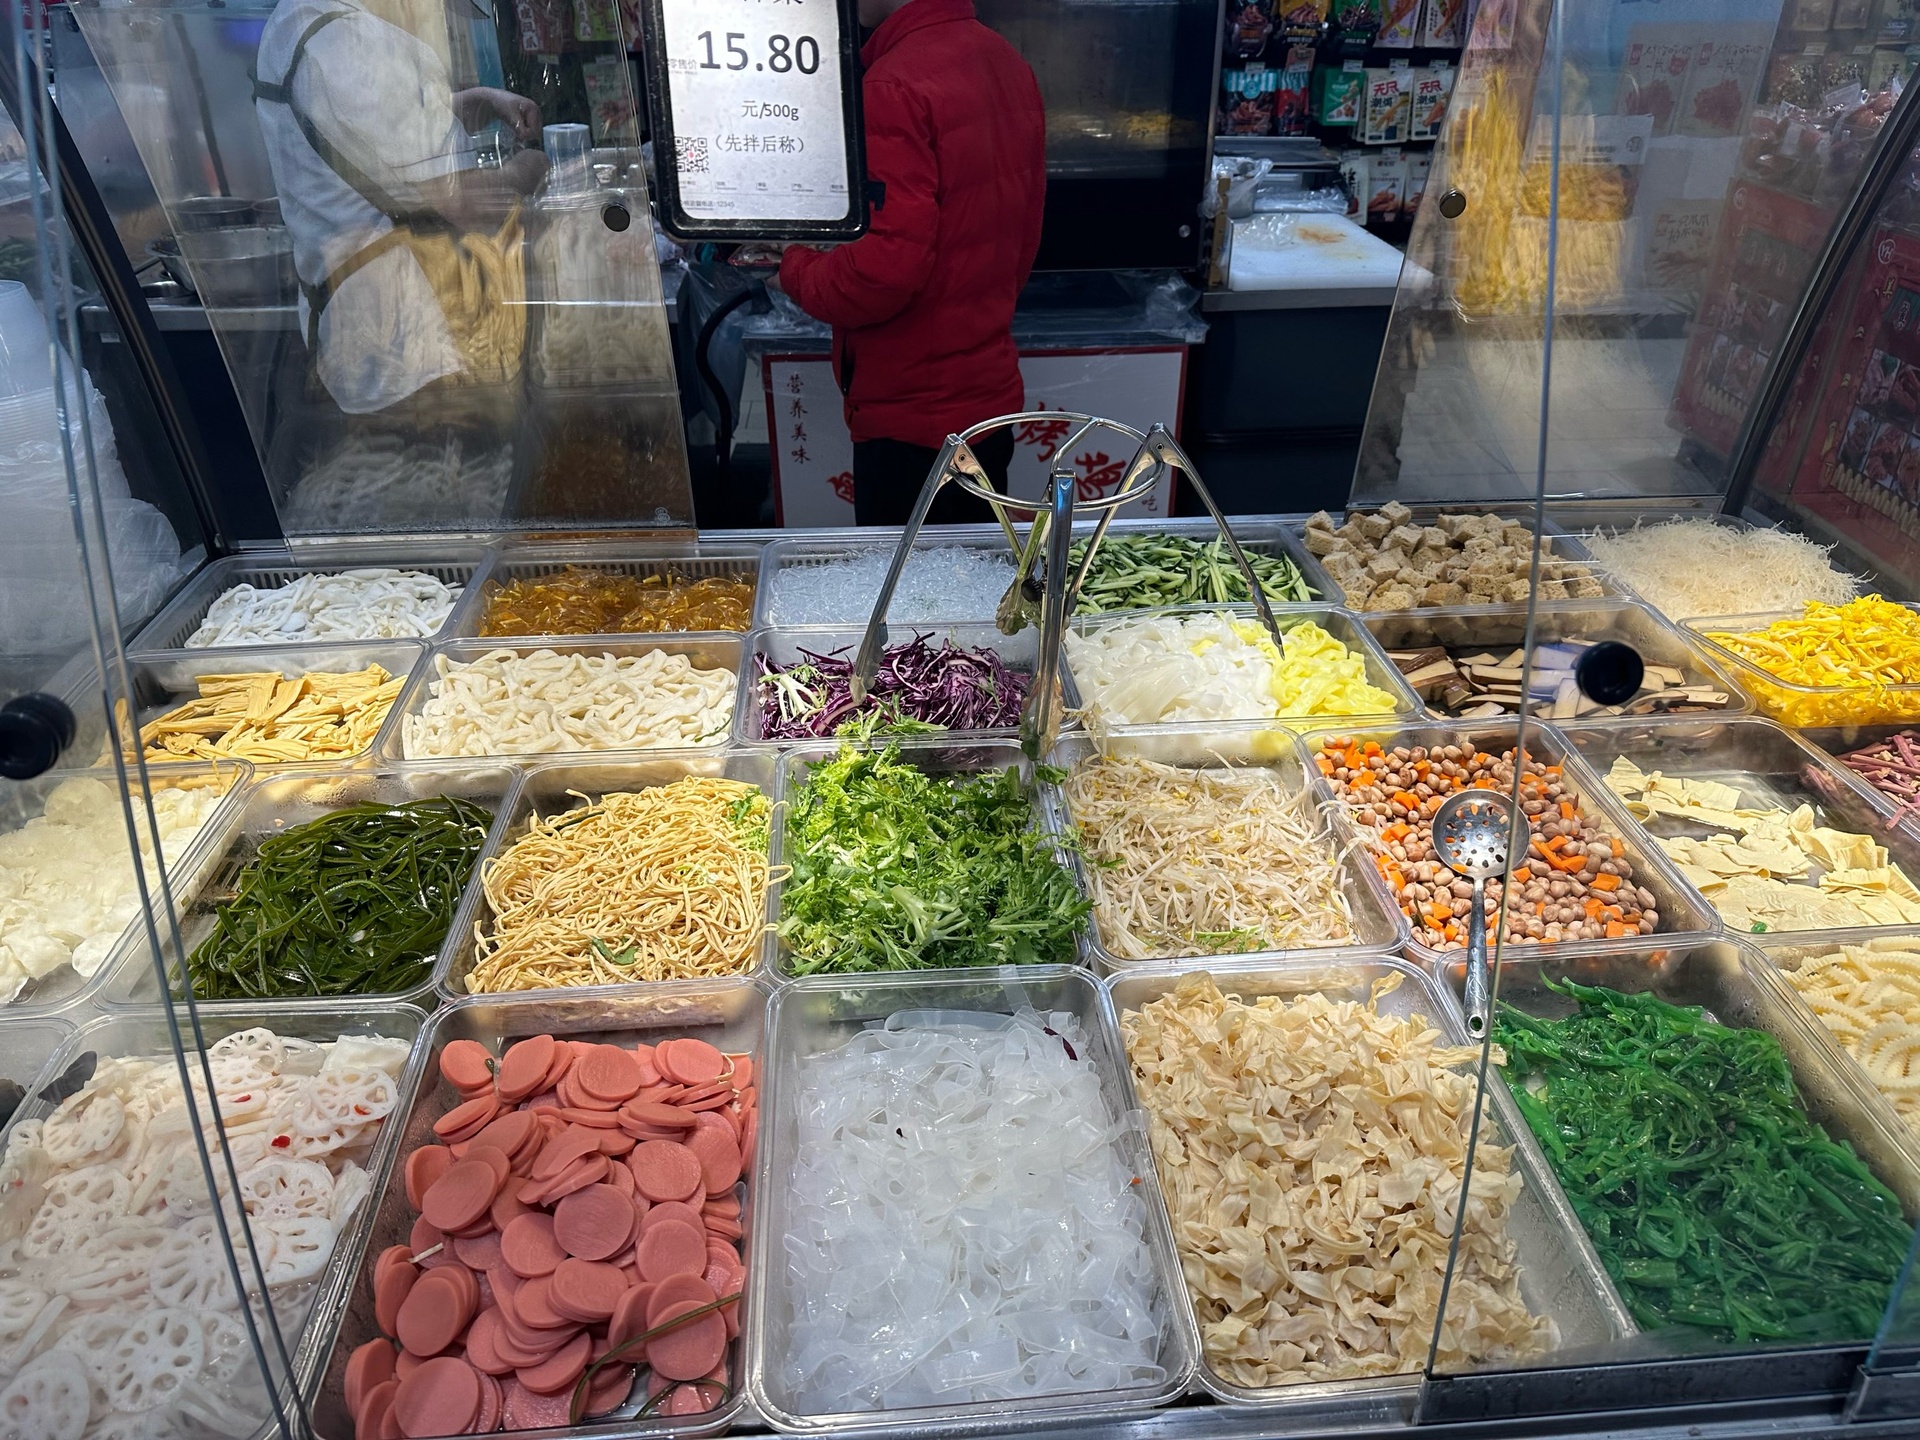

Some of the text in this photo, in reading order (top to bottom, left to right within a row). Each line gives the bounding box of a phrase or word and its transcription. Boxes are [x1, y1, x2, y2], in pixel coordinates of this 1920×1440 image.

[697, 30, 820, 75] 15.80
[741, 100, 800, 121] 元/500g
[786, 373, 812, 465] 营养美味
